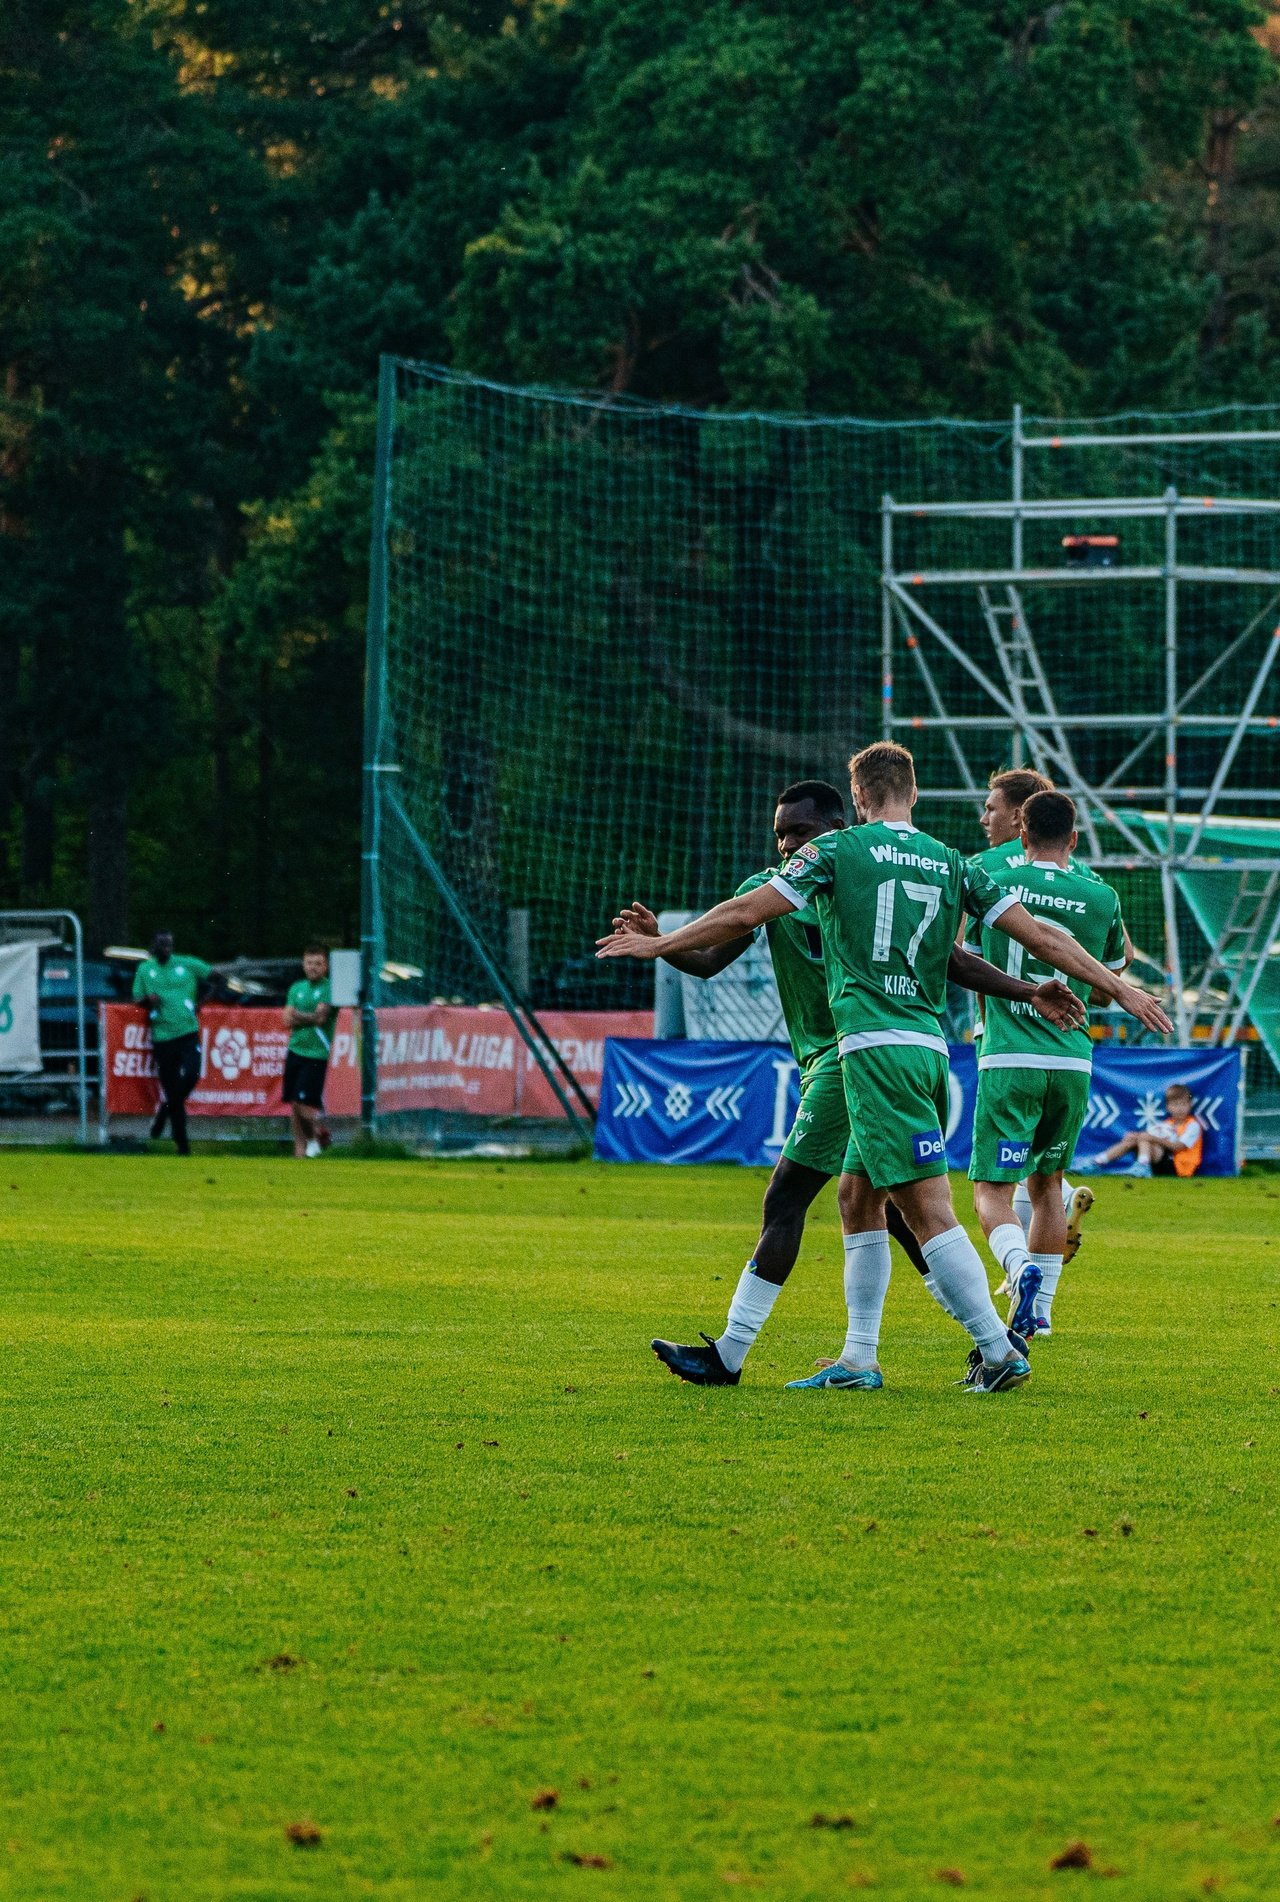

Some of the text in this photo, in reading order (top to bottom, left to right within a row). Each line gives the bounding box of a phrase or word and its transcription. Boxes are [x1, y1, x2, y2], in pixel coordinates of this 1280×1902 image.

[869, 844, 950, 876] Winnerz
[872, 878, 942, 967] 17
[884, 975, 919, 997] KIRSS
[455, 1033, 514, 1070] LIIGA
